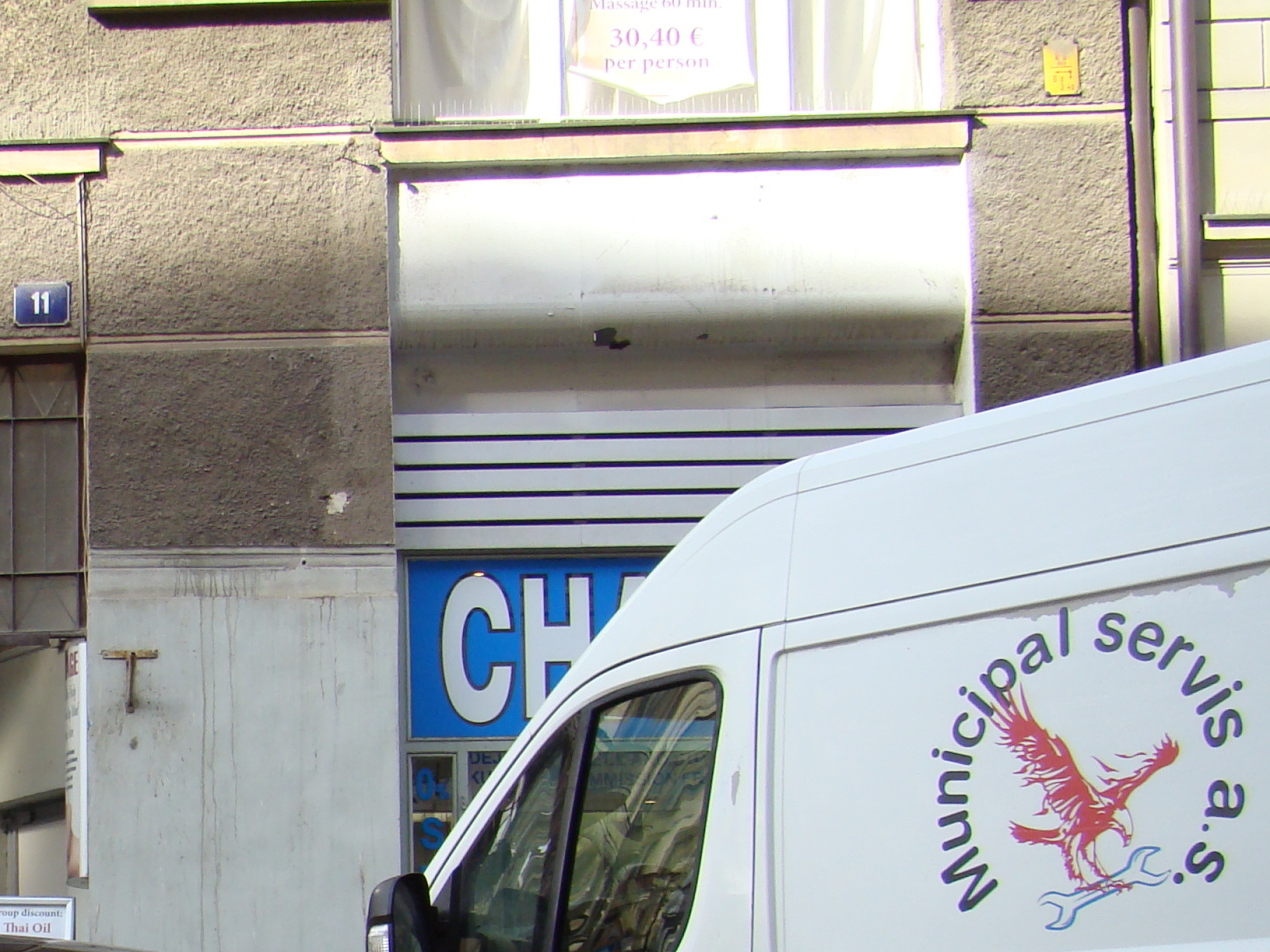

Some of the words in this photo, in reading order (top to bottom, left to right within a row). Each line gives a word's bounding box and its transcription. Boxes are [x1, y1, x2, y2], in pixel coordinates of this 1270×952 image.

[609, 26, 681, 50] 30,40
[689, 26, 705, 47] €
[604, 56, 636, 73] per
[642, 54, 710, 75] person
[31, 291, 50, 315] 11
[932, 606, 1070, 913] Municipal
[1093, 611, 1244, 748] servis
[21, 908, 64, 918] discount:
[3, 922, 29, 934] Thai
[32, 922, 52, 934] Oil
